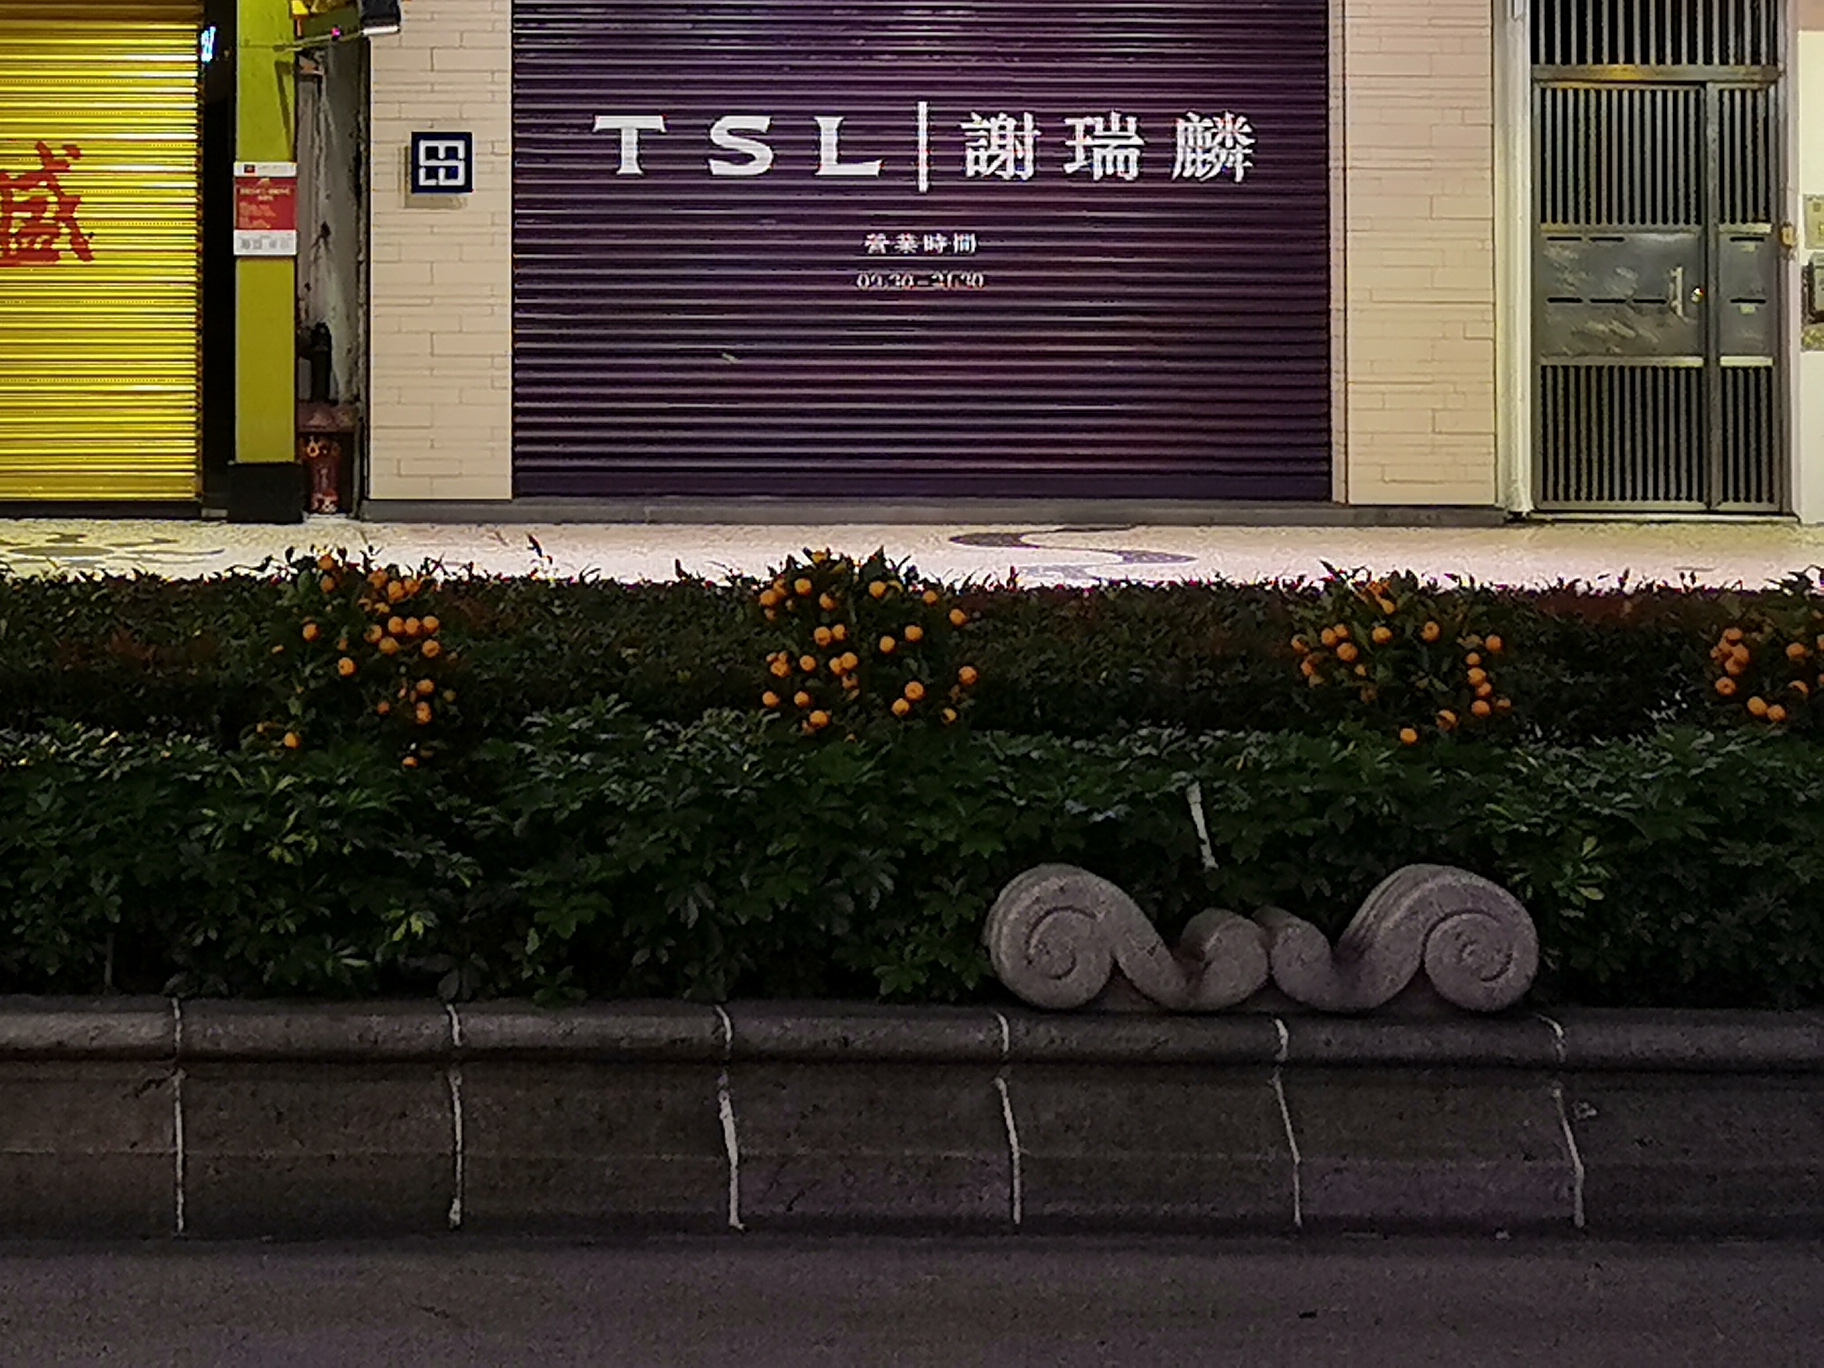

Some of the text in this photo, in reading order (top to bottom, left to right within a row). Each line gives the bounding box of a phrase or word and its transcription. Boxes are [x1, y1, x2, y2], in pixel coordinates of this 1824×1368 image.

[593, 113, 883, 178] TSL
[960, 109, 1256, 184] 謝瑞麟
[864, 232, 978, 255] 營業時間
